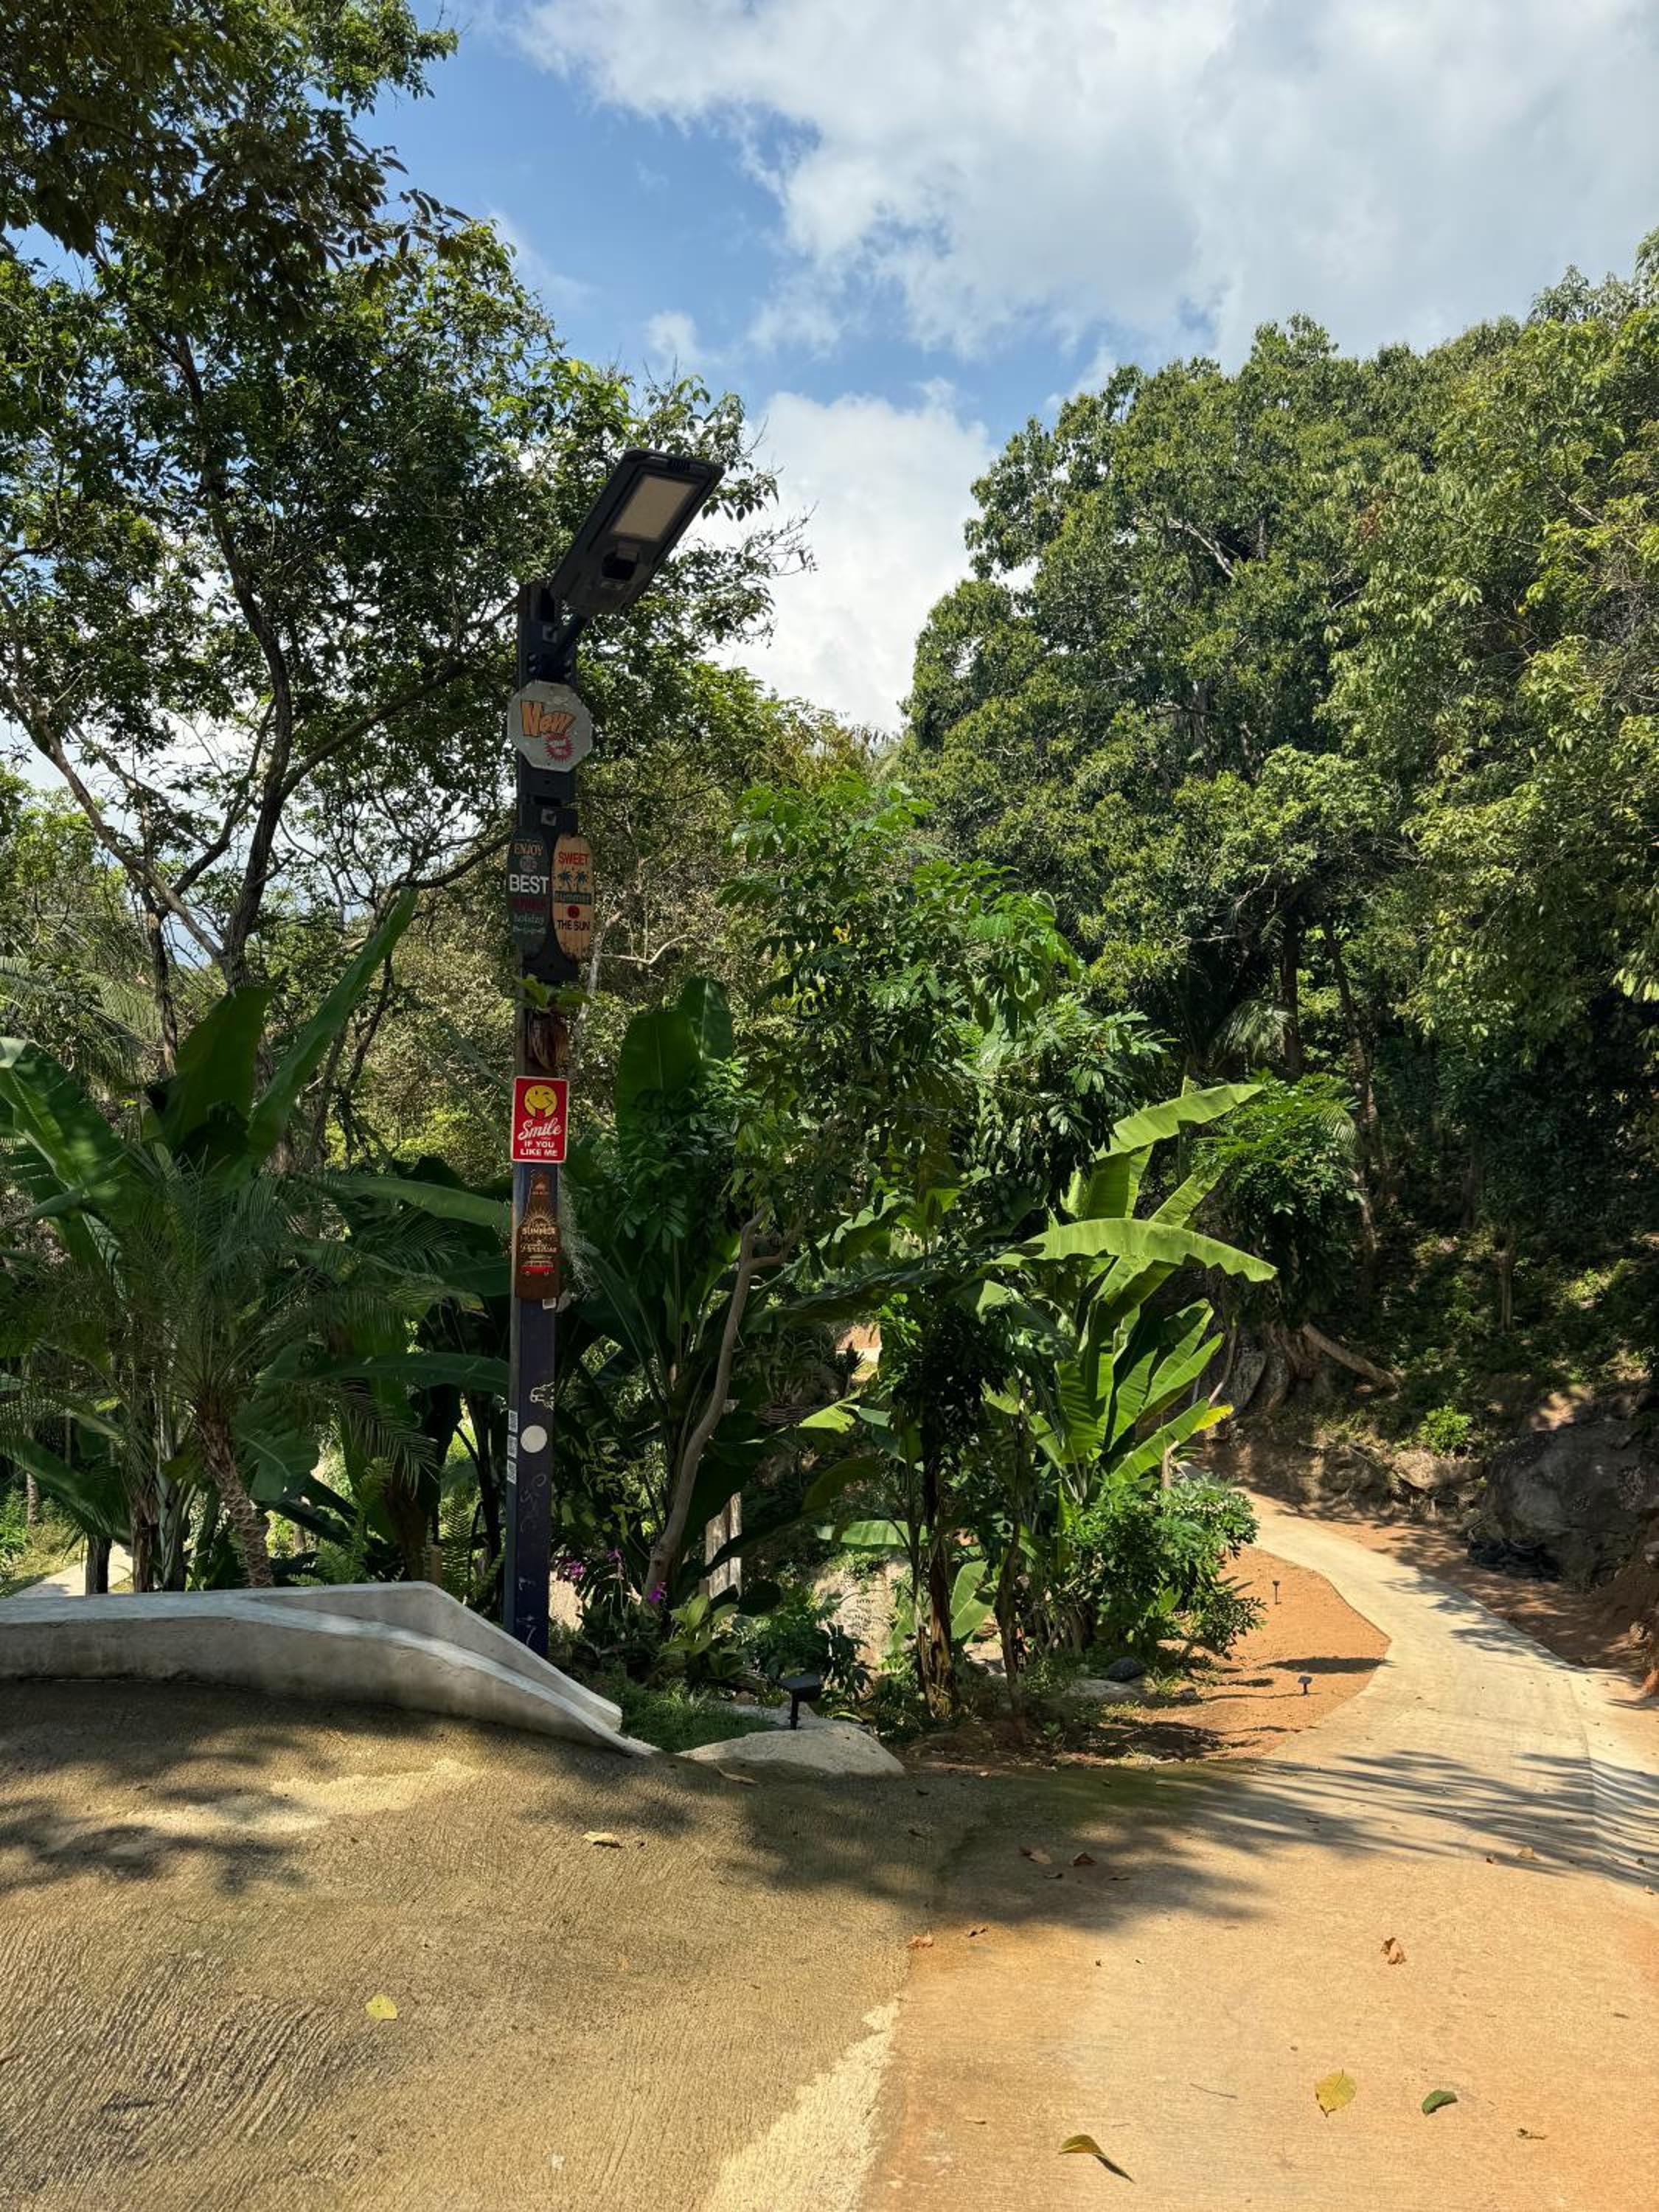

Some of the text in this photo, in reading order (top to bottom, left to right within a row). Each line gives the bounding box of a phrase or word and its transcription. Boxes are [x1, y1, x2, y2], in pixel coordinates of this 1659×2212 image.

[514, 843, 543, 855] ENJOY
[558, 852, 589, 865] SWEET
[509, 874, 549, 894] BEST
[557, 919, 590, 931] THE SUN
[518, 1118, 563, 1141] Smile
[520, 1148, 558, 1157] LIKE ME
